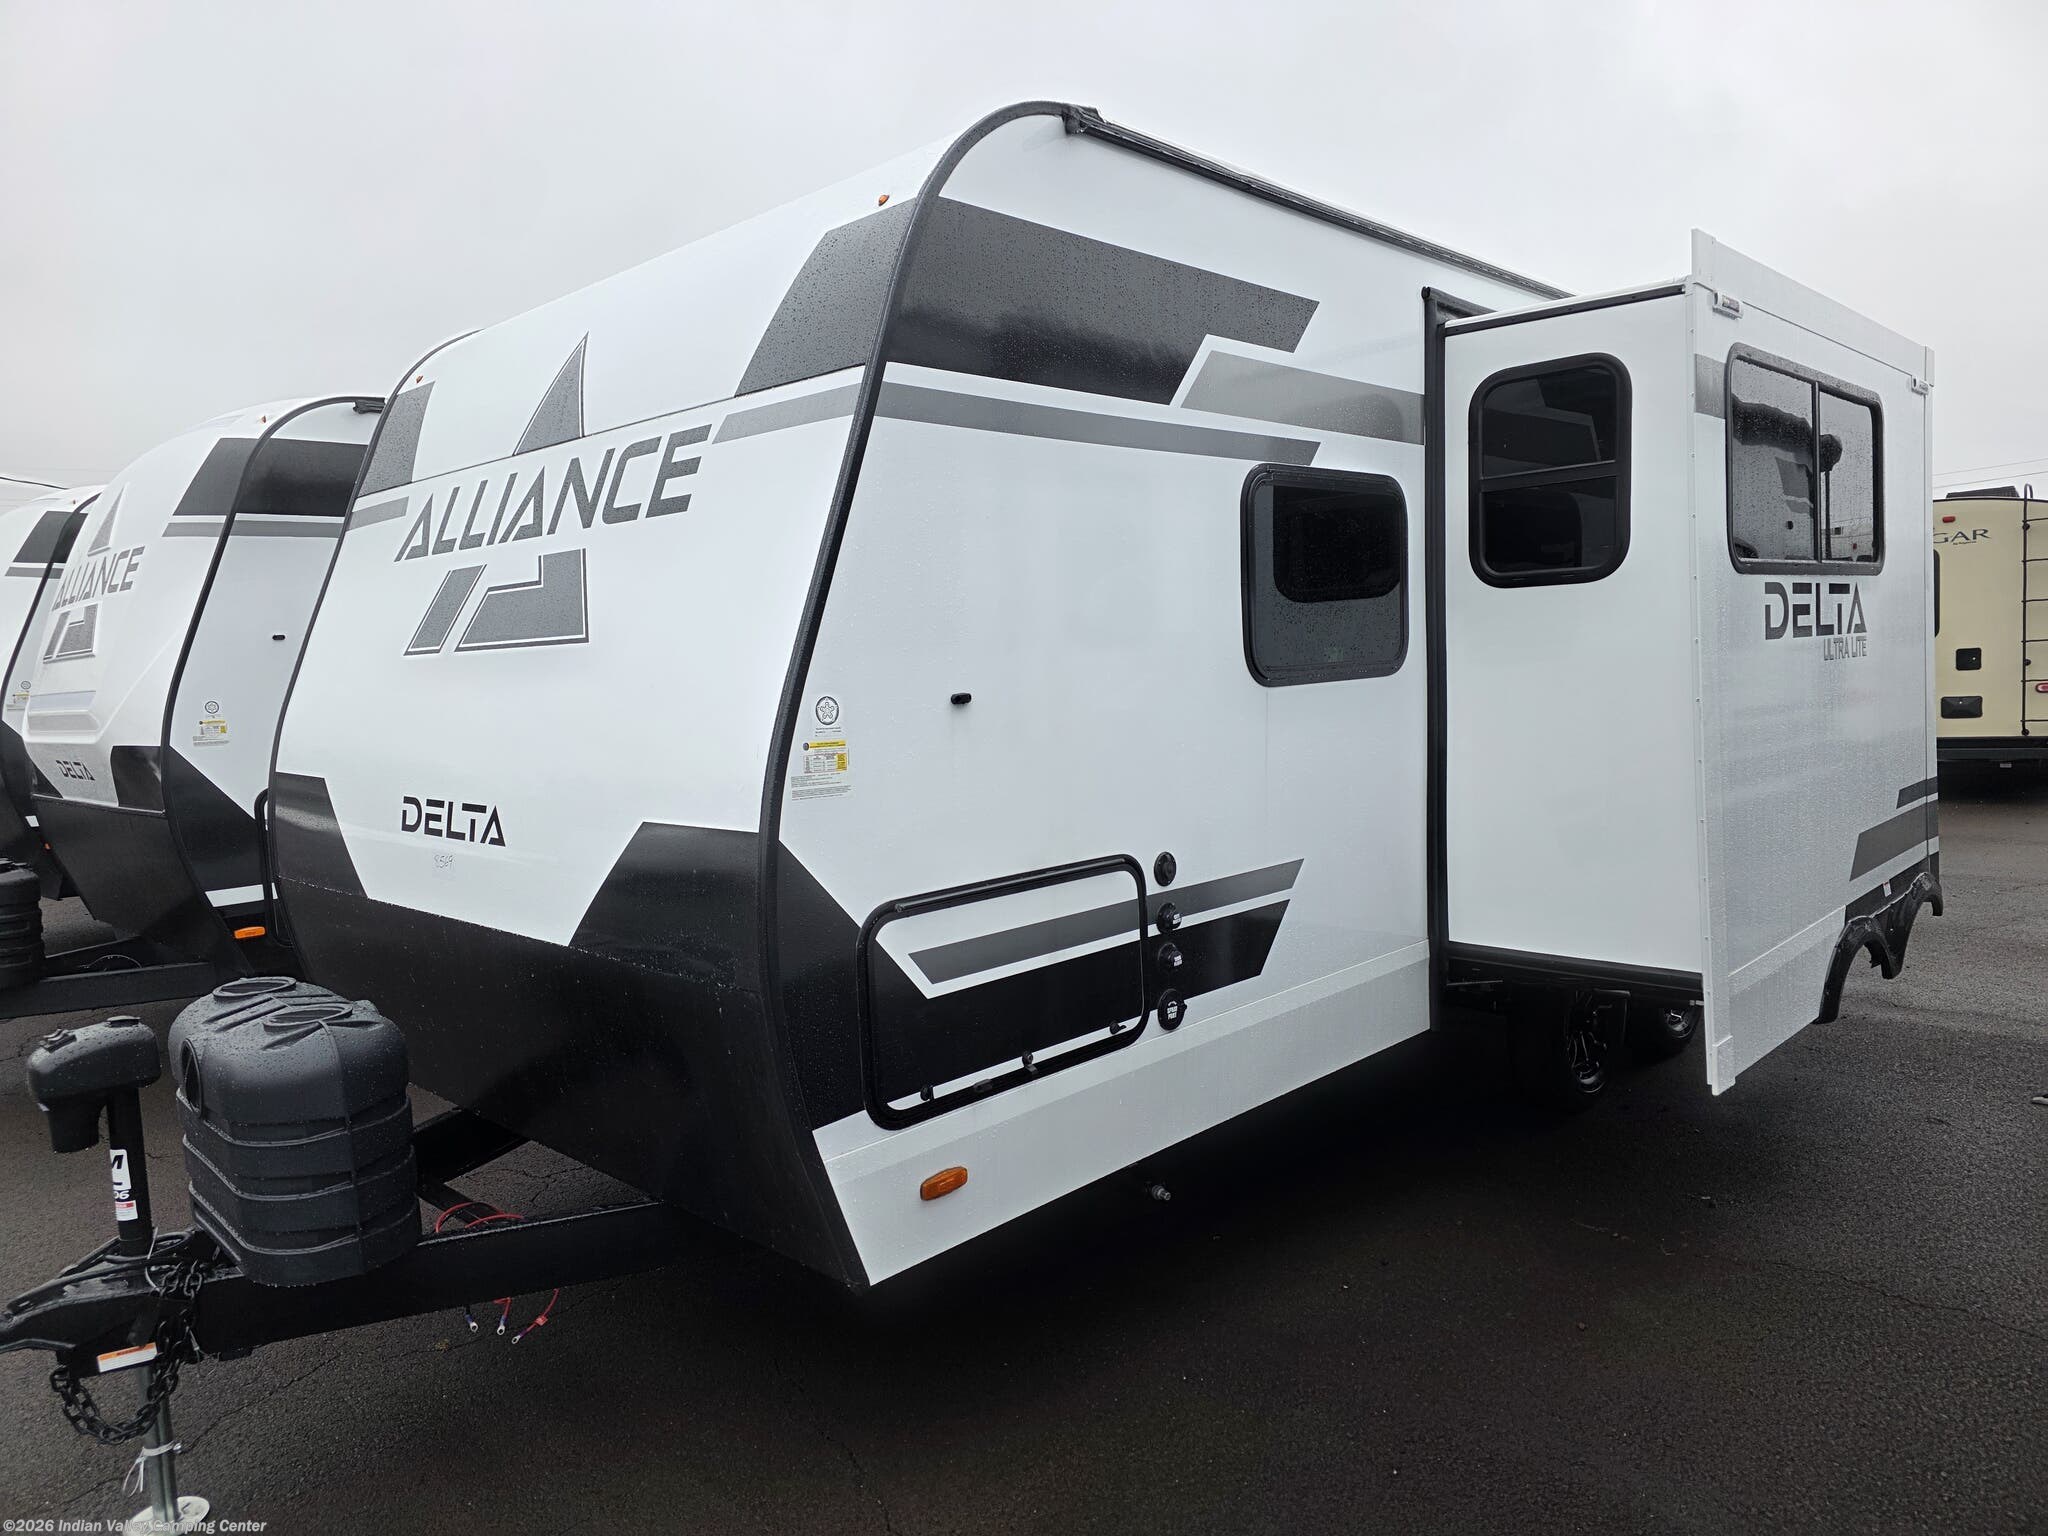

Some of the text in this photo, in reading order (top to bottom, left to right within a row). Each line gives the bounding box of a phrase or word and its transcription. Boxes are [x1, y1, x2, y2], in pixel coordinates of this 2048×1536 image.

[393, 423, 713, 562] ALLIANCE
[53, 546, 145, 611] ALLIANCE
[1764, 581, 1867, 640] DELTA
[1823, 635, 1867, 661] ULTRA LITE
[55, 760, 95, 782] DELTA
[401, 795, 506, 847] DELTA
